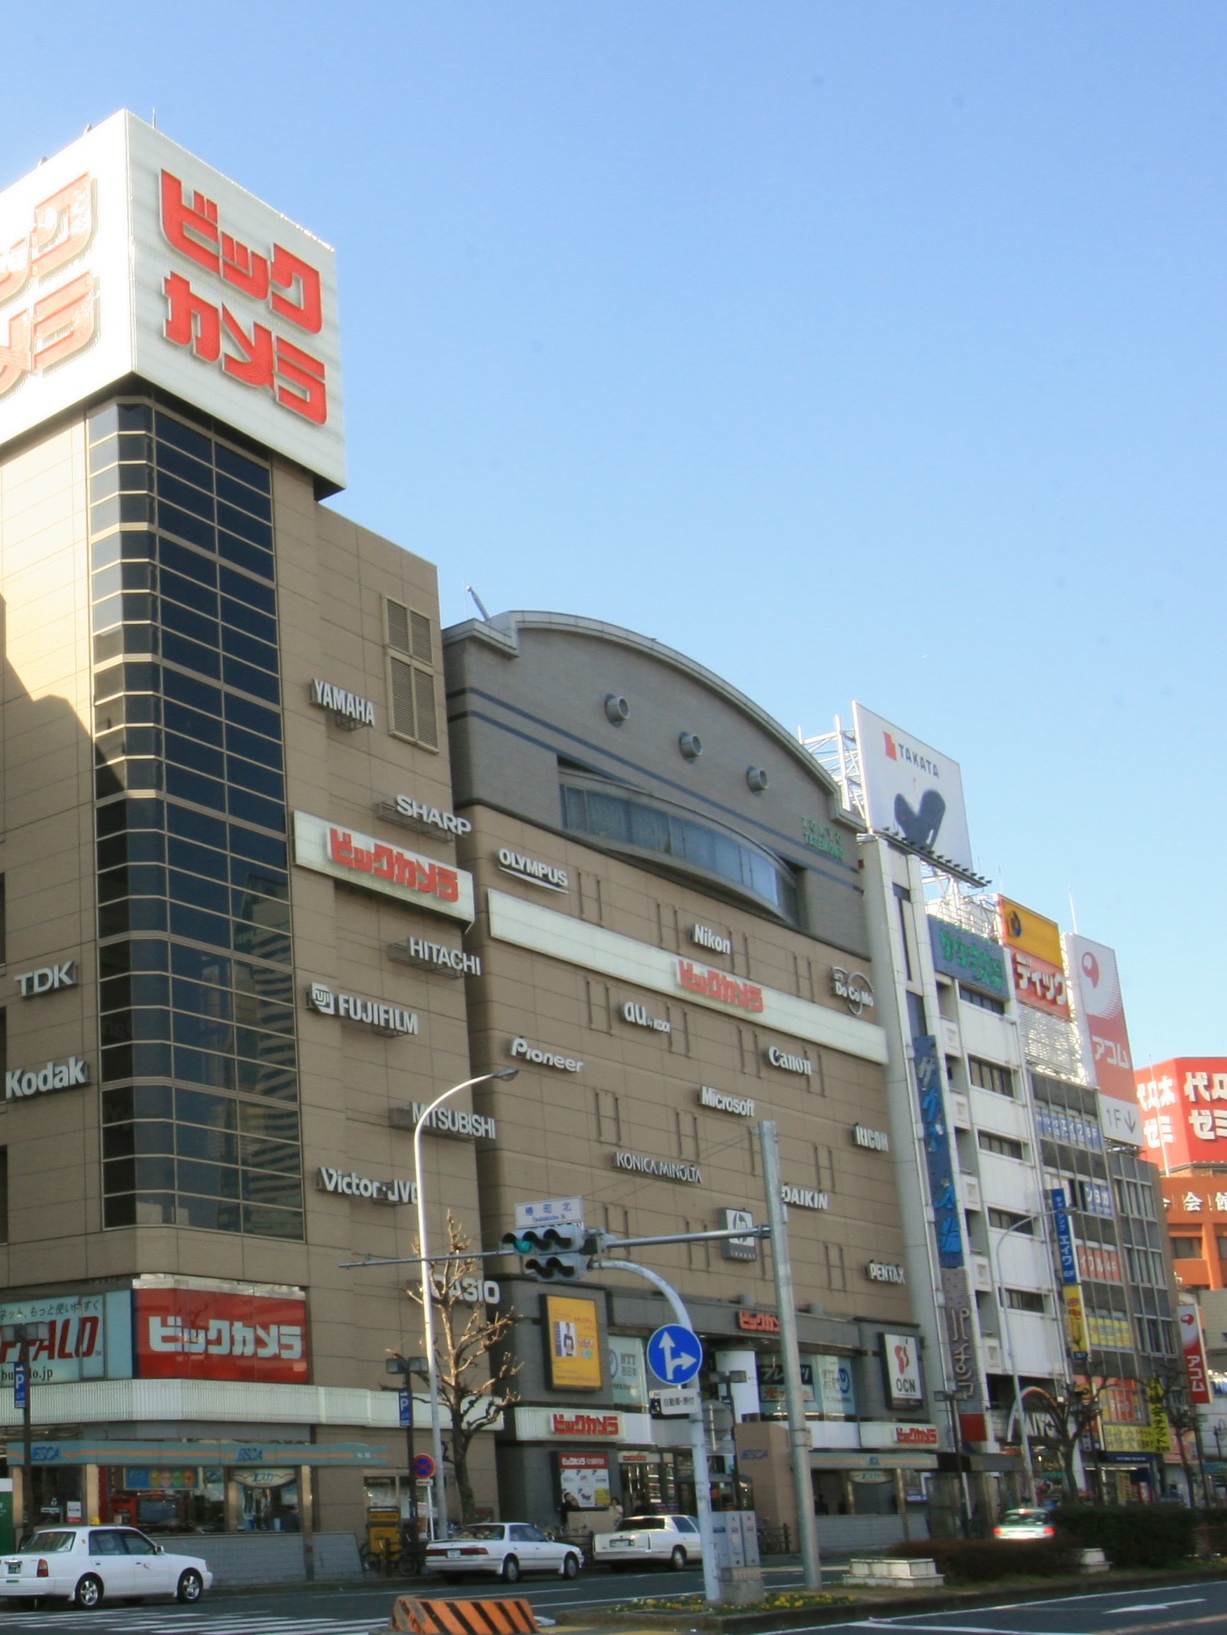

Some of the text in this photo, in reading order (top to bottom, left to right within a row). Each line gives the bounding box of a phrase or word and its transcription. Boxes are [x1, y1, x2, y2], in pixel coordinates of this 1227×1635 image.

[160, 169, 322, 334] ビック
[163, 271, 327, 425] カメラ
[313, 679, 374, 727] YAMAHA
[897, 742, 940, 780] TAKATA
[395, 795, 472, 837] SHARP
[329, 826, 460, 903] ビックカメラ
[498, 848, 569, 888] OLYMPUS
[693, 923, 731, 955] Nikon
[408, 937, 482, 977] HITACHI
[14, 960, 76, 998] TDK
[677, 959, 764, 1014] ビックカメラ
[337, 993, 420, 1036] FUJIFILM
[624, 1001, 647, 1027] au
[510, 1037, 585, 1073] Pioneer
[768, 1045, 812, 1076] Canon
[1092, 1035, 1129, 1069] アコム
[5, 1055, 87, 1100] Kodak
[701, 1085, 756, 1118] Microsoft
[1105, 1106, 1122, 1127] 1F
[855, 1124, 890, 1152] RICOH
[1144, 1114, 1174, 1149] ゼミ
[320, 1166, 380, 1199] Victor
[615, 1151, 703, 1184] KONICA MINOLTA
[780, 1184, 829, 1211] DAIKIN
[869, 1262, 906, 1285] PENTAX
[148, 1315, 302, 1360] ビックカメラ
[2, 1365, 53, 1381] bulo.jp
[896, 1377, 916, 1394] OCN
[1187, 1354, 1206, 1392] アコム
[552, 1413, 619, 1436] ビックカメラ
[895, 1426, 938, 1444] ビックカメラ
